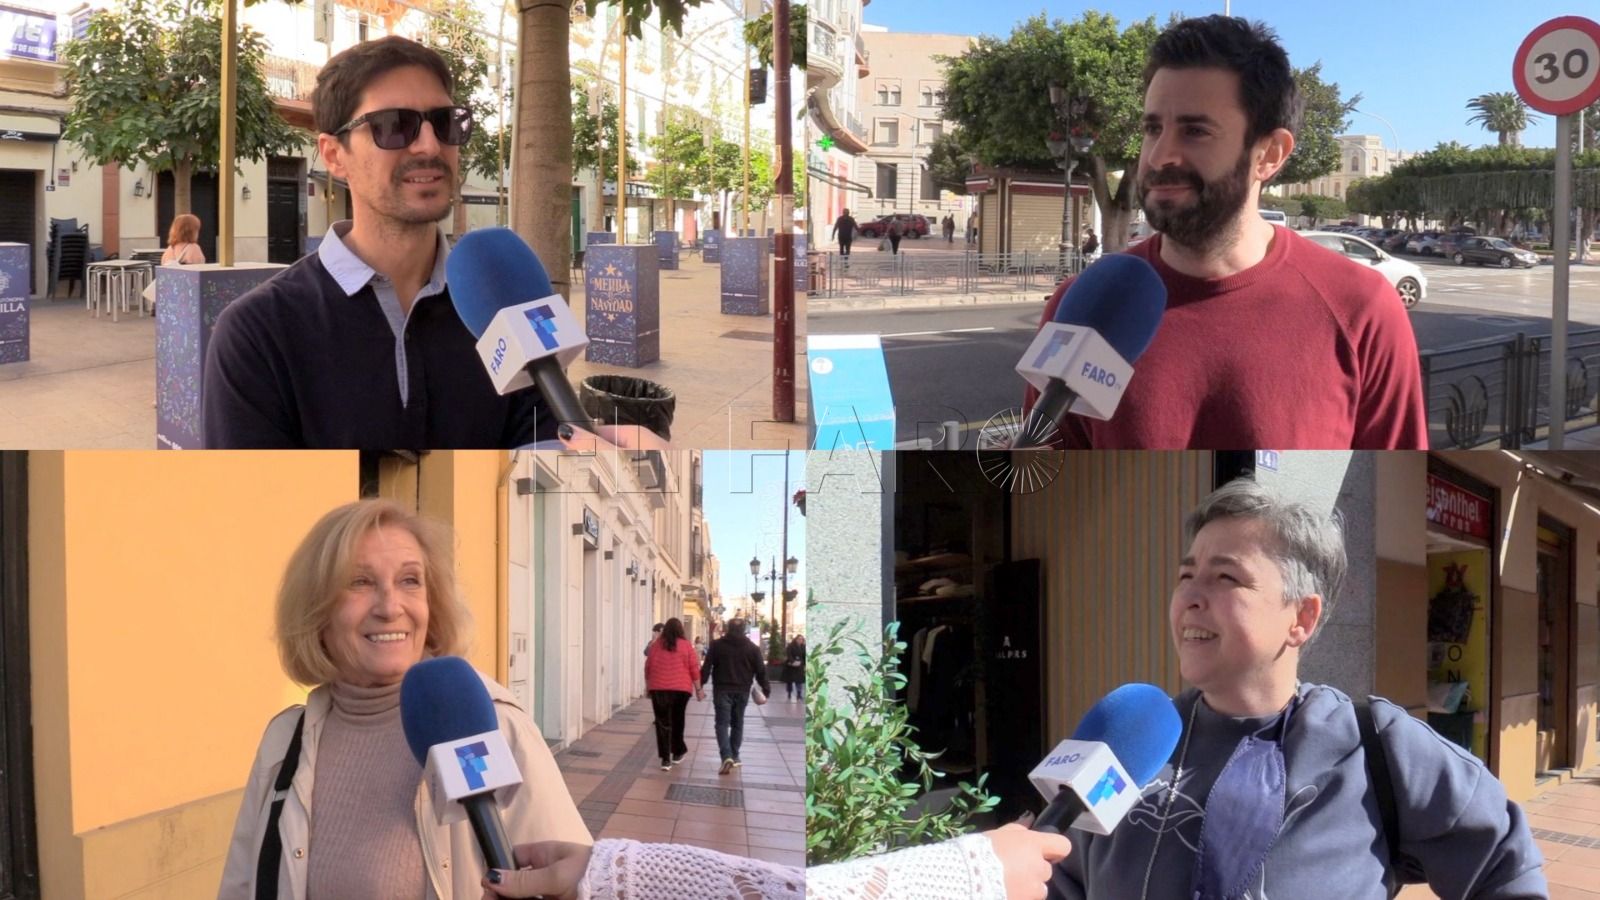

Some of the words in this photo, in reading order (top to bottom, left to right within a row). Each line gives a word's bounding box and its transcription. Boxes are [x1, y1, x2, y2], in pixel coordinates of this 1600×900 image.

[1534, 48, 1589, 84] 30
[490, 338, 507, 376] FARO
[1081, 362, 1117, 388] FARO
[1044, 753, 1080, 767] FARO
